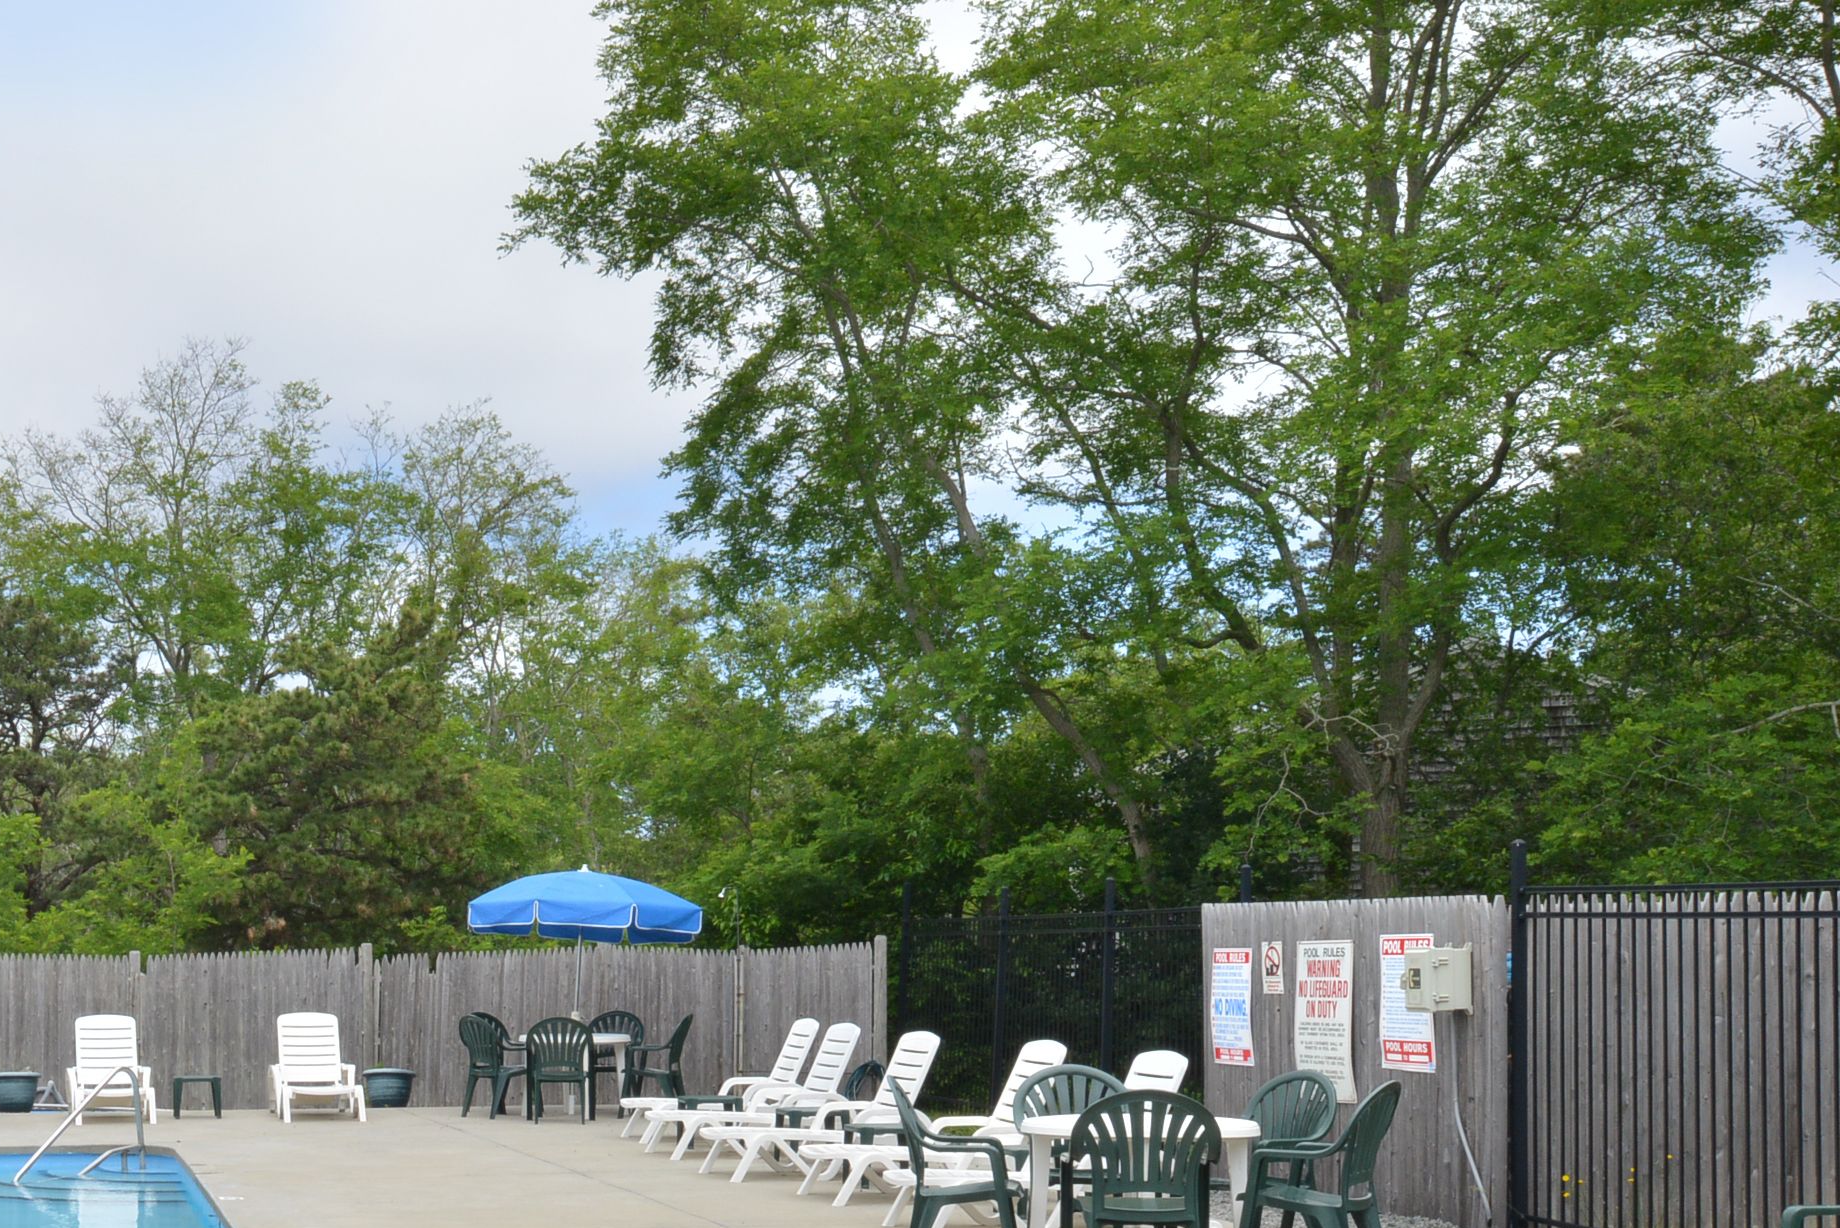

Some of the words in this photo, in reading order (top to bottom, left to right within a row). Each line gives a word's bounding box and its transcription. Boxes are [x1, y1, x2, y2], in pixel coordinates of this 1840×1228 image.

[1304, 948, 1320, 958] POOL
[1323, 947, 1345, 957] RULES
[1383, 940, 1402, 953] POOL
[1215, 952, 1227, 963] POOL
[1229, 952, 1246, 963] RULES
[1307, 959, 1341, 977] WARNING
[1298, 980, 1308, 997] NO
[1310, 980, 1348, 998] LIFEGUARD
[1215, 998, 1223, 1015] NO
[1306, 1001, 1316, 1017] ON
[1318, 1001, 1337, 1018] DUTY
[1385, 1042, 1401, 1051] POOL
[1403, 1042, 1427, 1053] HOURS
